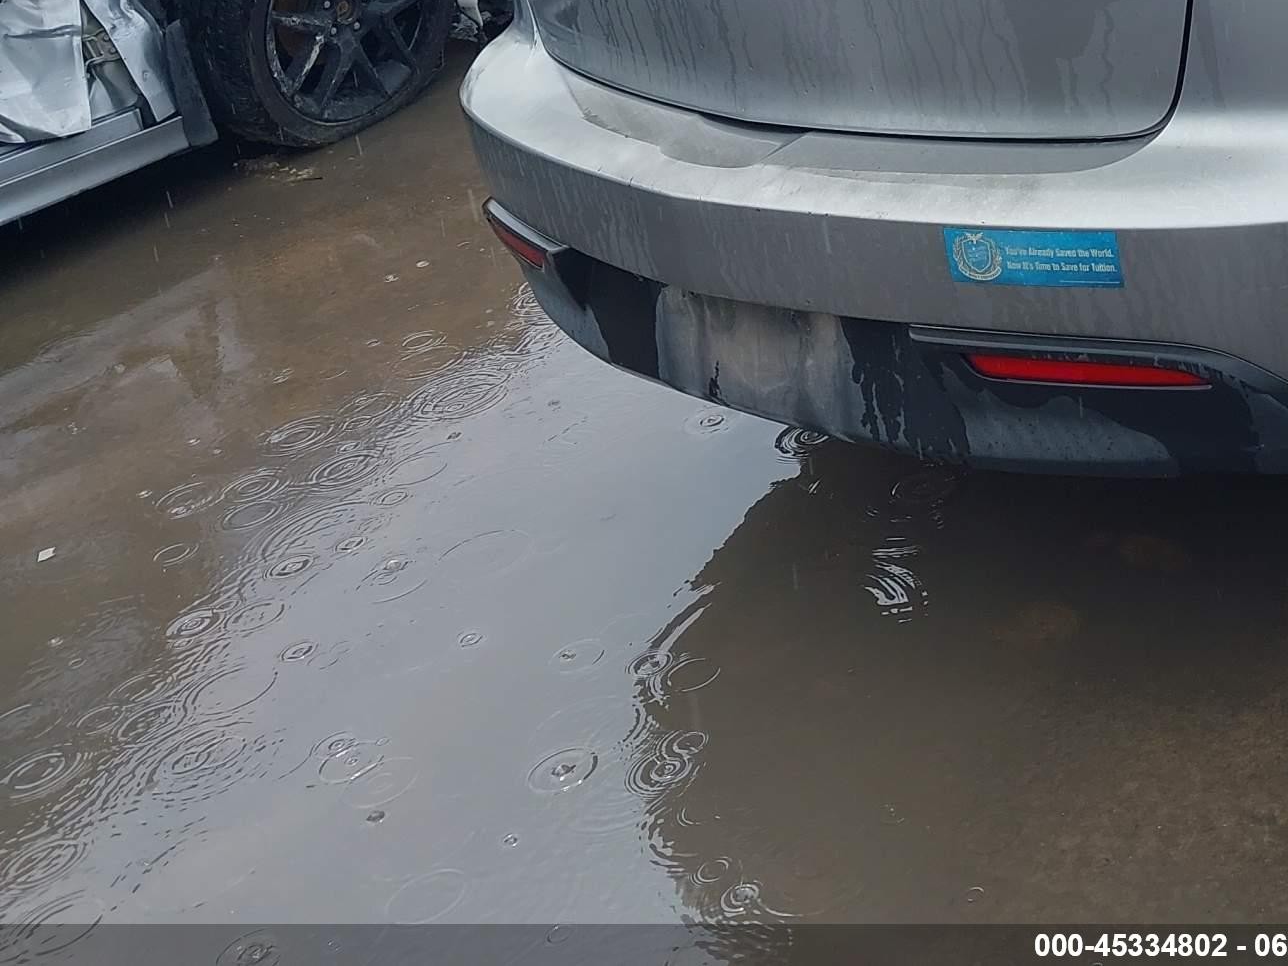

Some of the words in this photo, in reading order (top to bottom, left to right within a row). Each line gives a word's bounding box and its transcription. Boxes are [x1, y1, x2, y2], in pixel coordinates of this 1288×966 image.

[1028, 246, 1054, 259] Already
[1055, 247, 1077, 258] Saved
[1077, 247, 1090, 258] the
[1090, 248, 1115, 259] World.
[1006, 260, 1021, 270] Now
[1034, 261, 1051, 271] Time
[1051, 263, 1060, 271] to
[1060, 262, 1079, 272] Save
[1079, 262, 1090, 272] for
[1091, 262, 1118, 273] Tuition.
